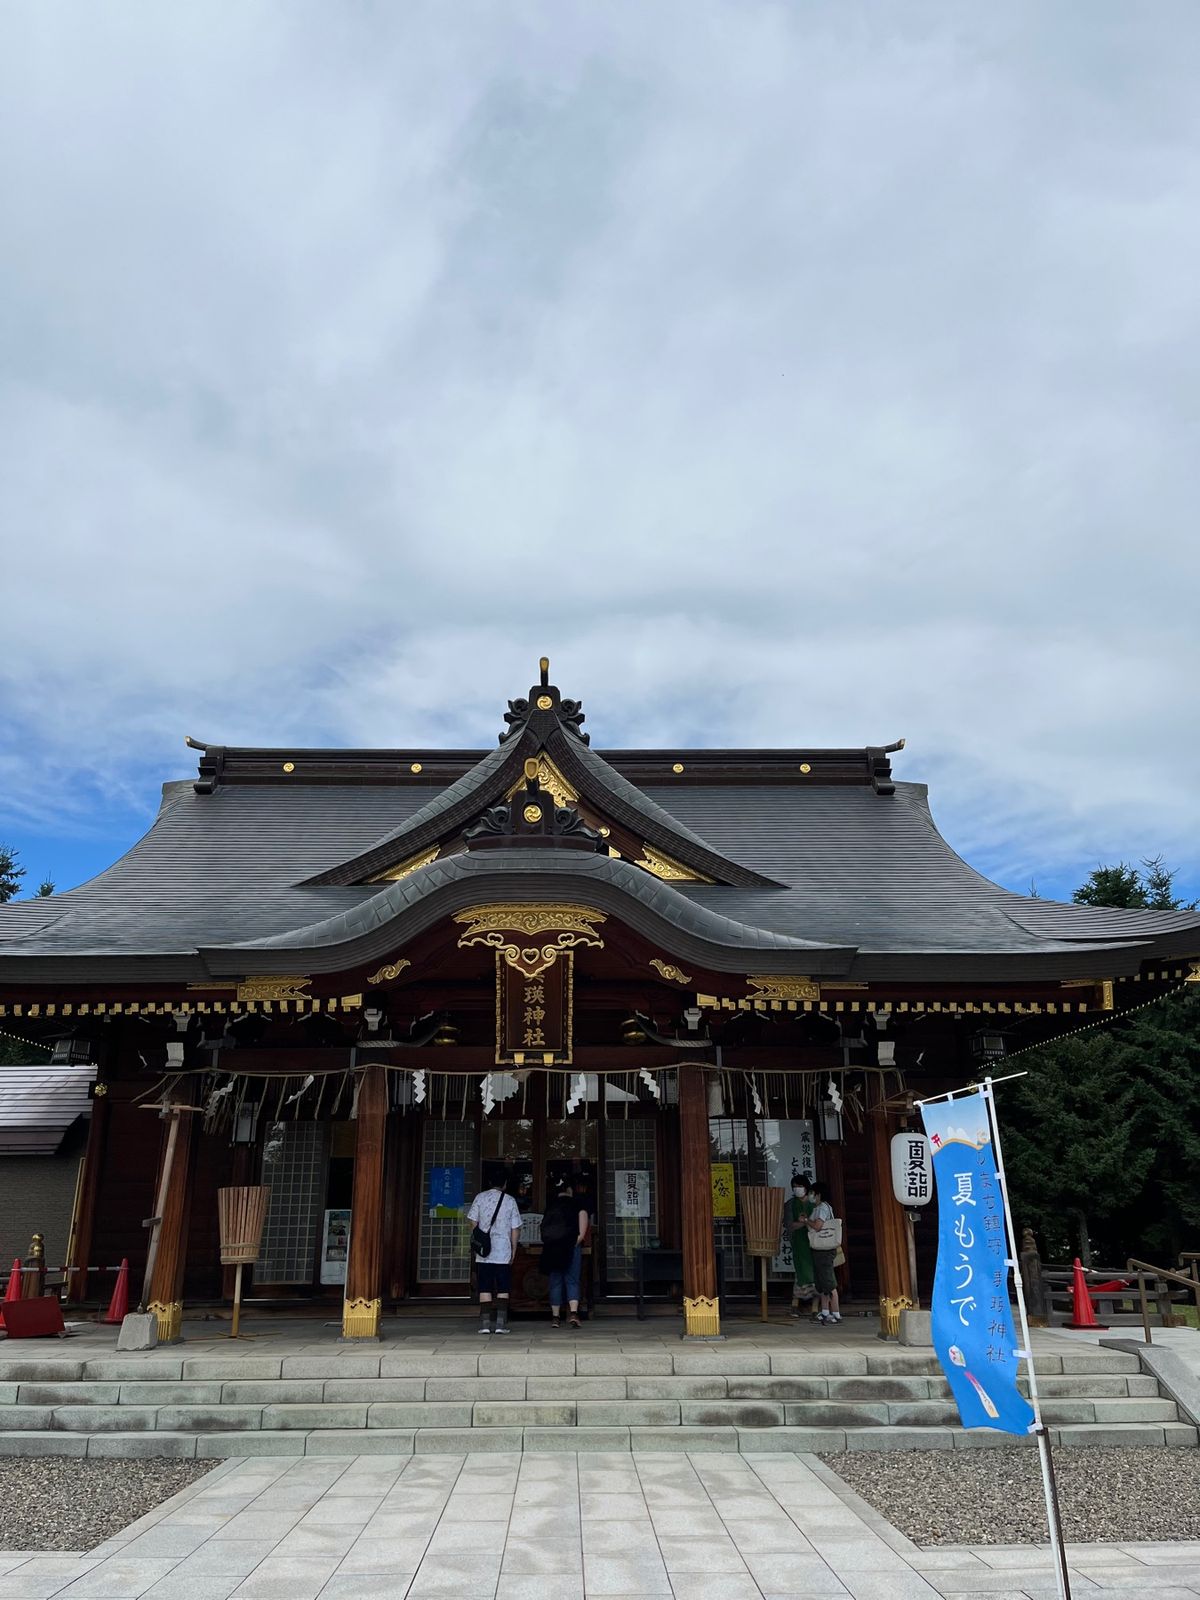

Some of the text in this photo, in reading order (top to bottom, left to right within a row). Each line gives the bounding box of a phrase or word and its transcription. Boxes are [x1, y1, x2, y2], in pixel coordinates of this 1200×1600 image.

[626, 1173, 639, 1206] 夏詣
[907, 1140, 928, 1198] 夏詣
[950, 1172, 977, 1327] 夏もうで
